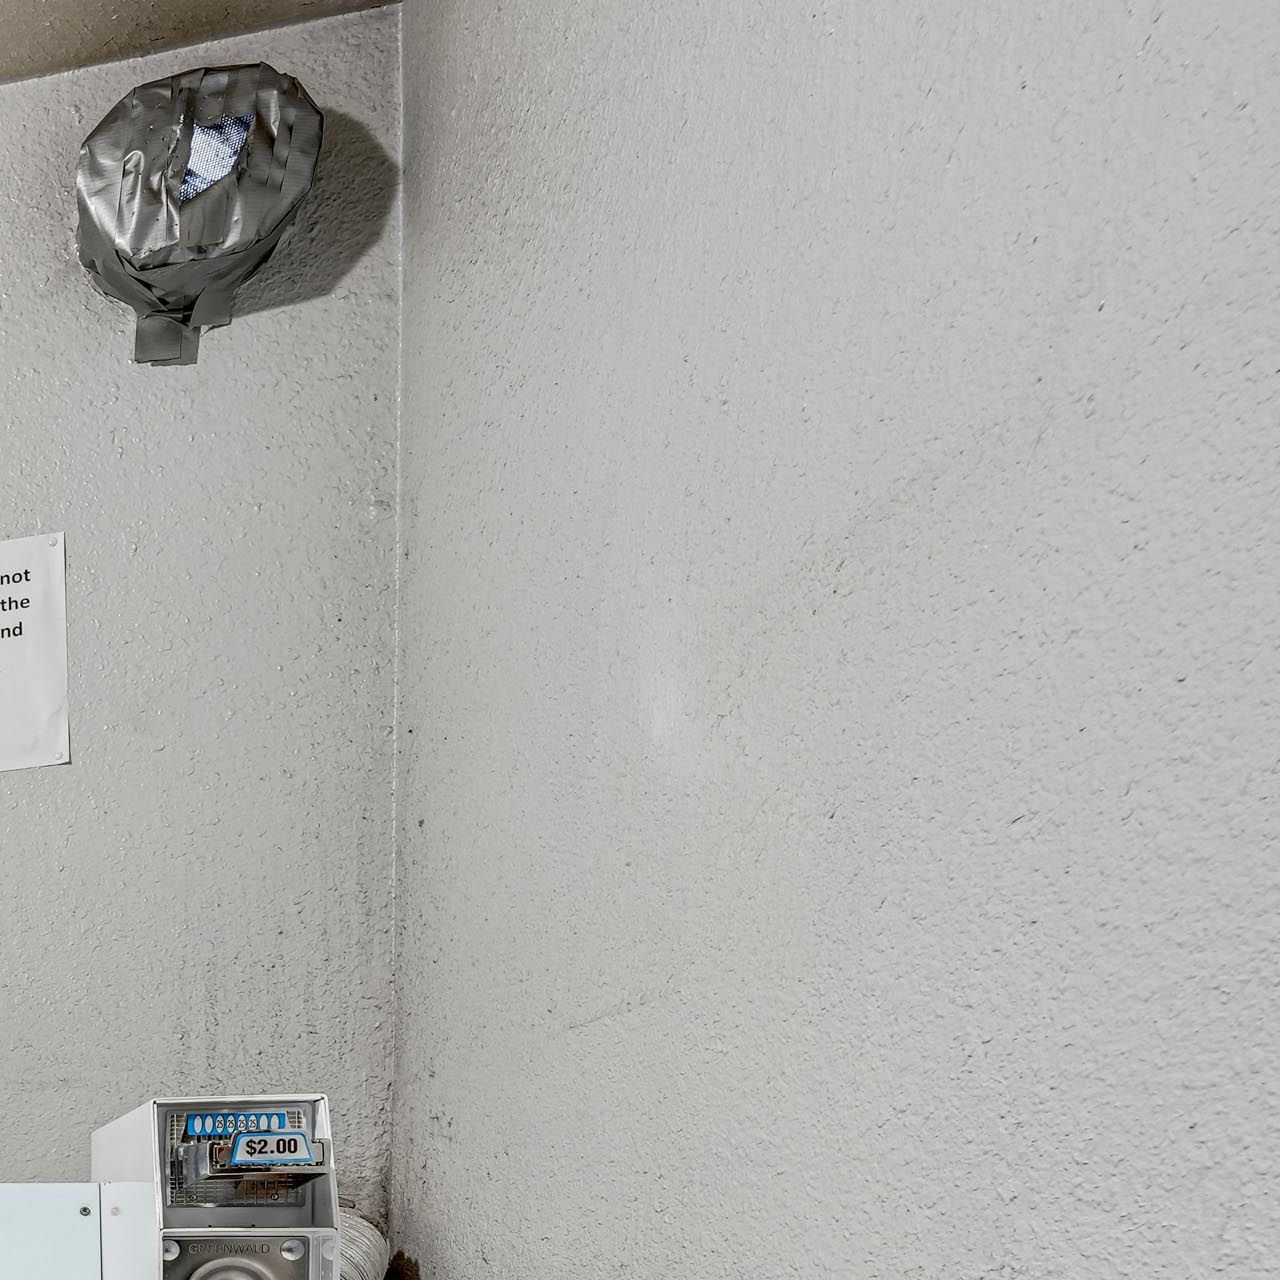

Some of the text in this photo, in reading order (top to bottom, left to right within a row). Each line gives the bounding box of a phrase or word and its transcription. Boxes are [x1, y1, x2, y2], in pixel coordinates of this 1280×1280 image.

[1, 569, 30, 585] not
[0, 597, 30, 611] the
[217, 1119, 256, 1129] 25 25 25 25
[246, 1138, 298, 1157] $2.00
[189, 1243, 271, 1254] GREENWALD
